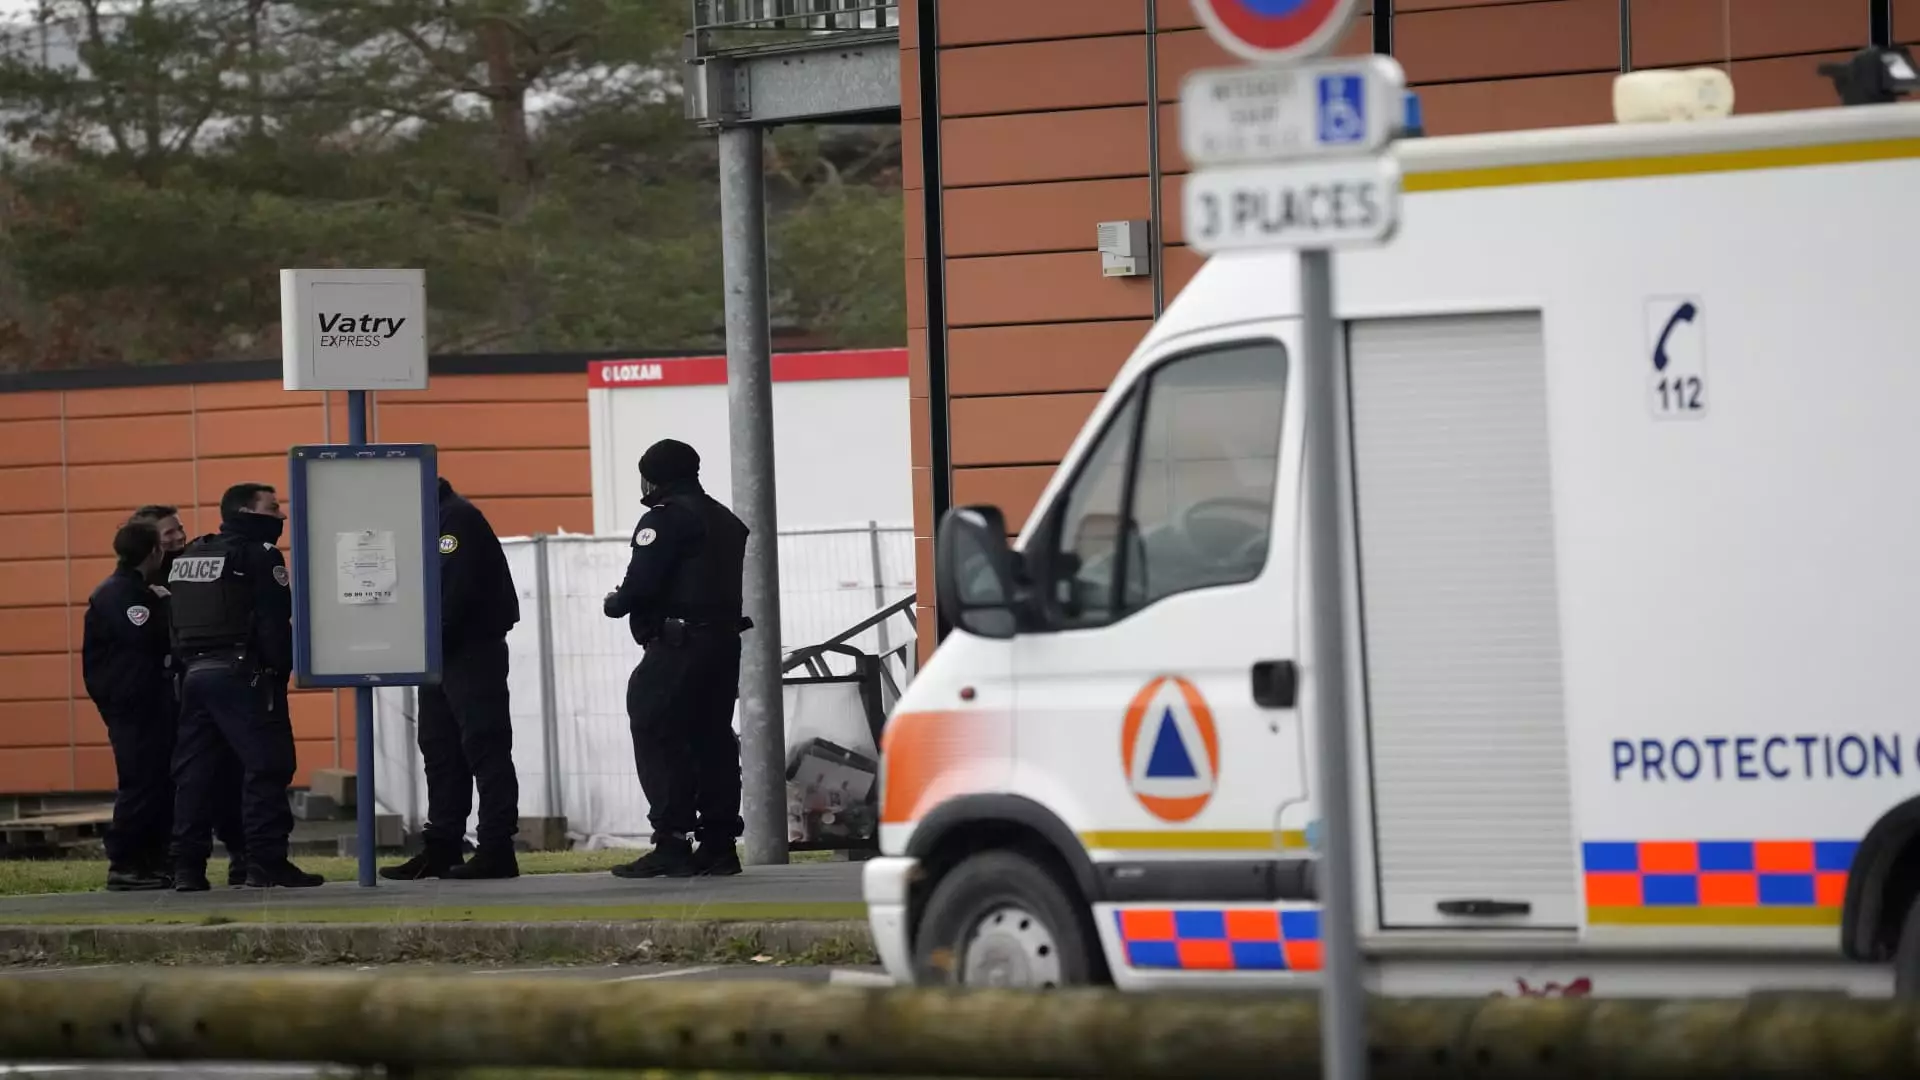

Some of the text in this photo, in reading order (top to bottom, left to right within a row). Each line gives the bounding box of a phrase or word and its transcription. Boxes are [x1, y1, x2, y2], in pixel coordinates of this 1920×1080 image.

[1199, 182, 1379, 239] 3 PLACES
[318, 312, 406, 338] Vatry
[320, 335, 381, 347] EXPRESS
[613, 364, 663, 381] LOXAM
[1657, 376, 1703, 410] 112
[170, 560, 221, 580] POLICE
[1612, 734, 1903, 782] PROTECTION
